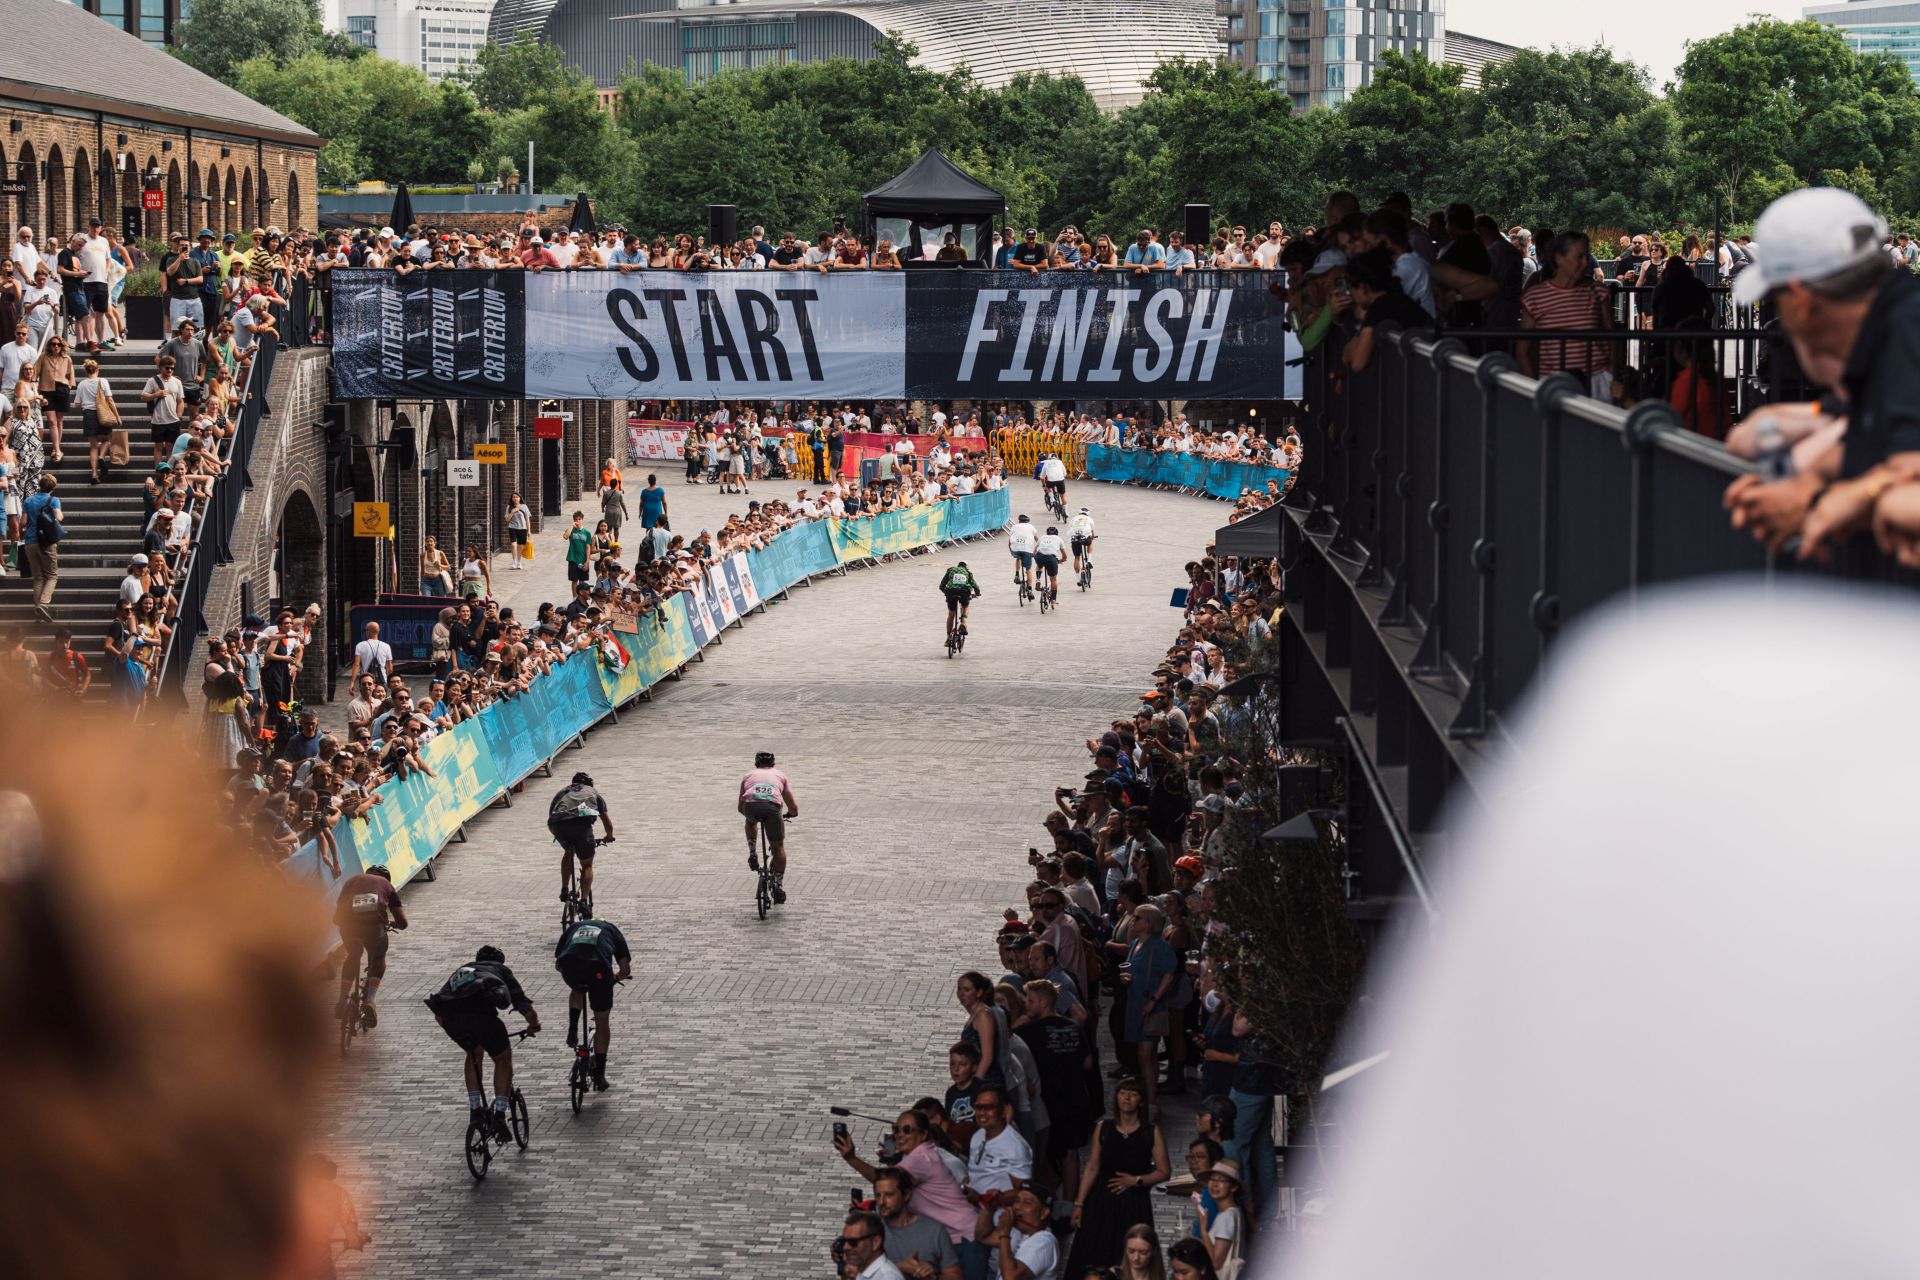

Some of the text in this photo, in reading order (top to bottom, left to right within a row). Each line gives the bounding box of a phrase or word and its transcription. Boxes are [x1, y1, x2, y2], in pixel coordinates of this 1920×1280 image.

[2, 183, 27, 192] ba&sh
[381, 286, 404, 381] CRITERIUM
[432, 287, 455, 381] CRITERIUM
[483, 287, 506, 382] CRITERIUM
[605, 287, 825, 383] START
[956, 288, 1234, 383] FINISH
[755, 787, 773, 795] 526
